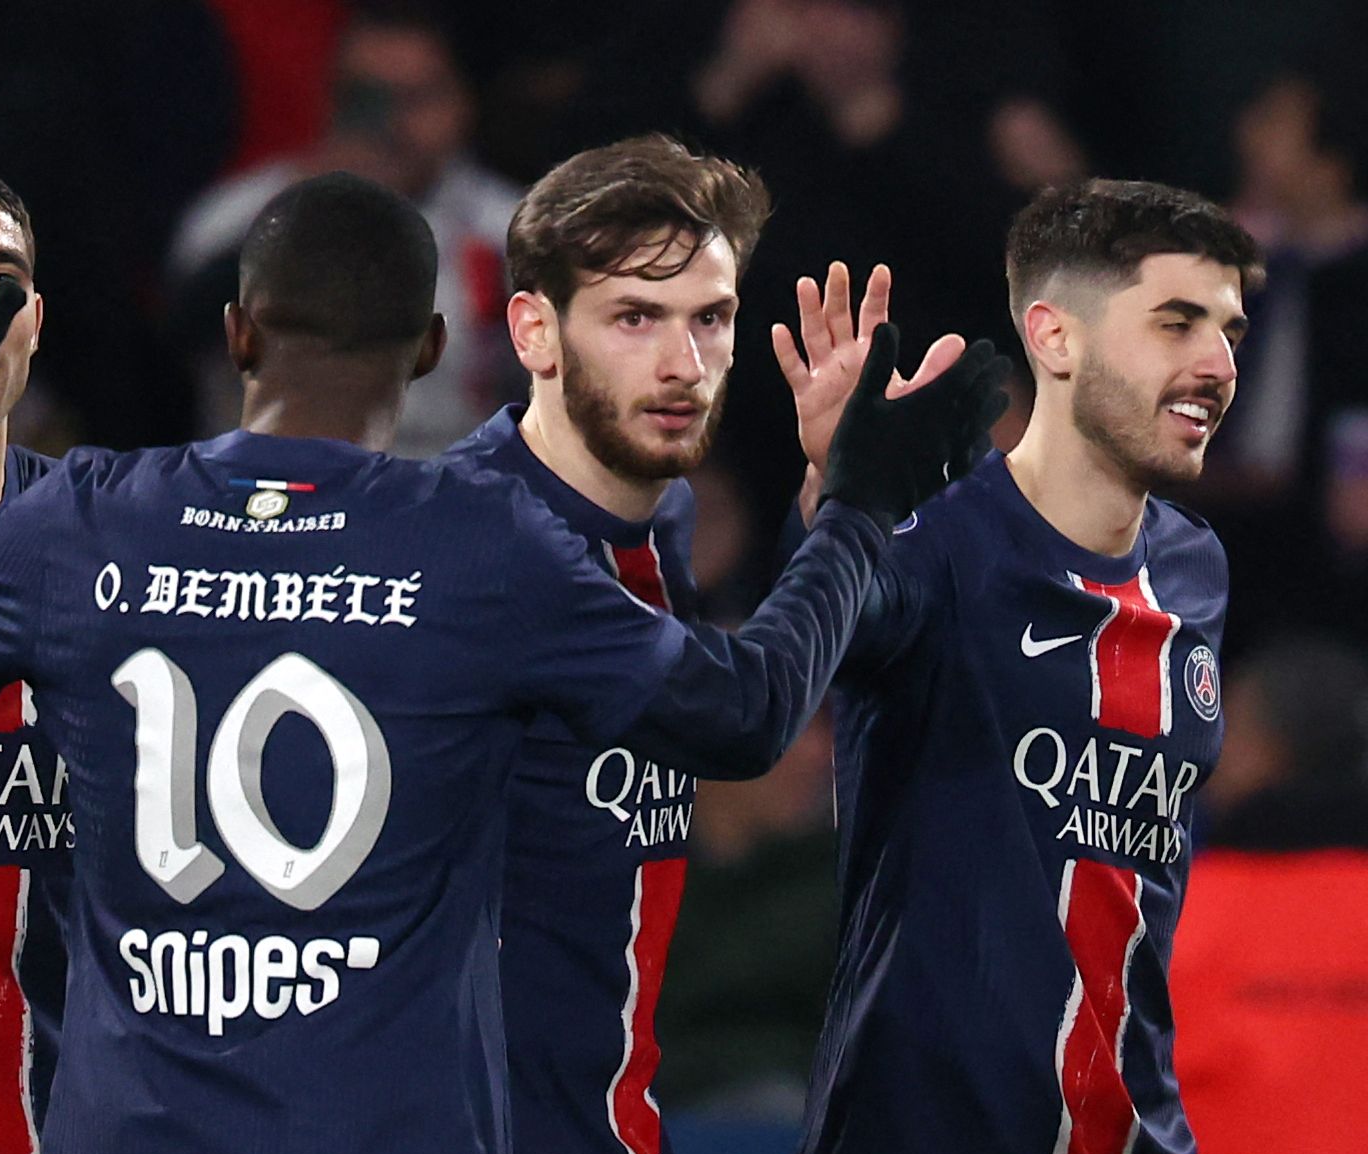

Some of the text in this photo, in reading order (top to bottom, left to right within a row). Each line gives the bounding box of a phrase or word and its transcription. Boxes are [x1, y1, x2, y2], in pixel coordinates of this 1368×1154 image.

[140, 565, 422, 628] DEMBÉLÉ
[111, 648, 391, 910] 10
[1014, 727, 1198, 822] QATAR
[1056, 805, 1182, 864] AIRWAYS
[119, 929, 340, 1036] snipes
